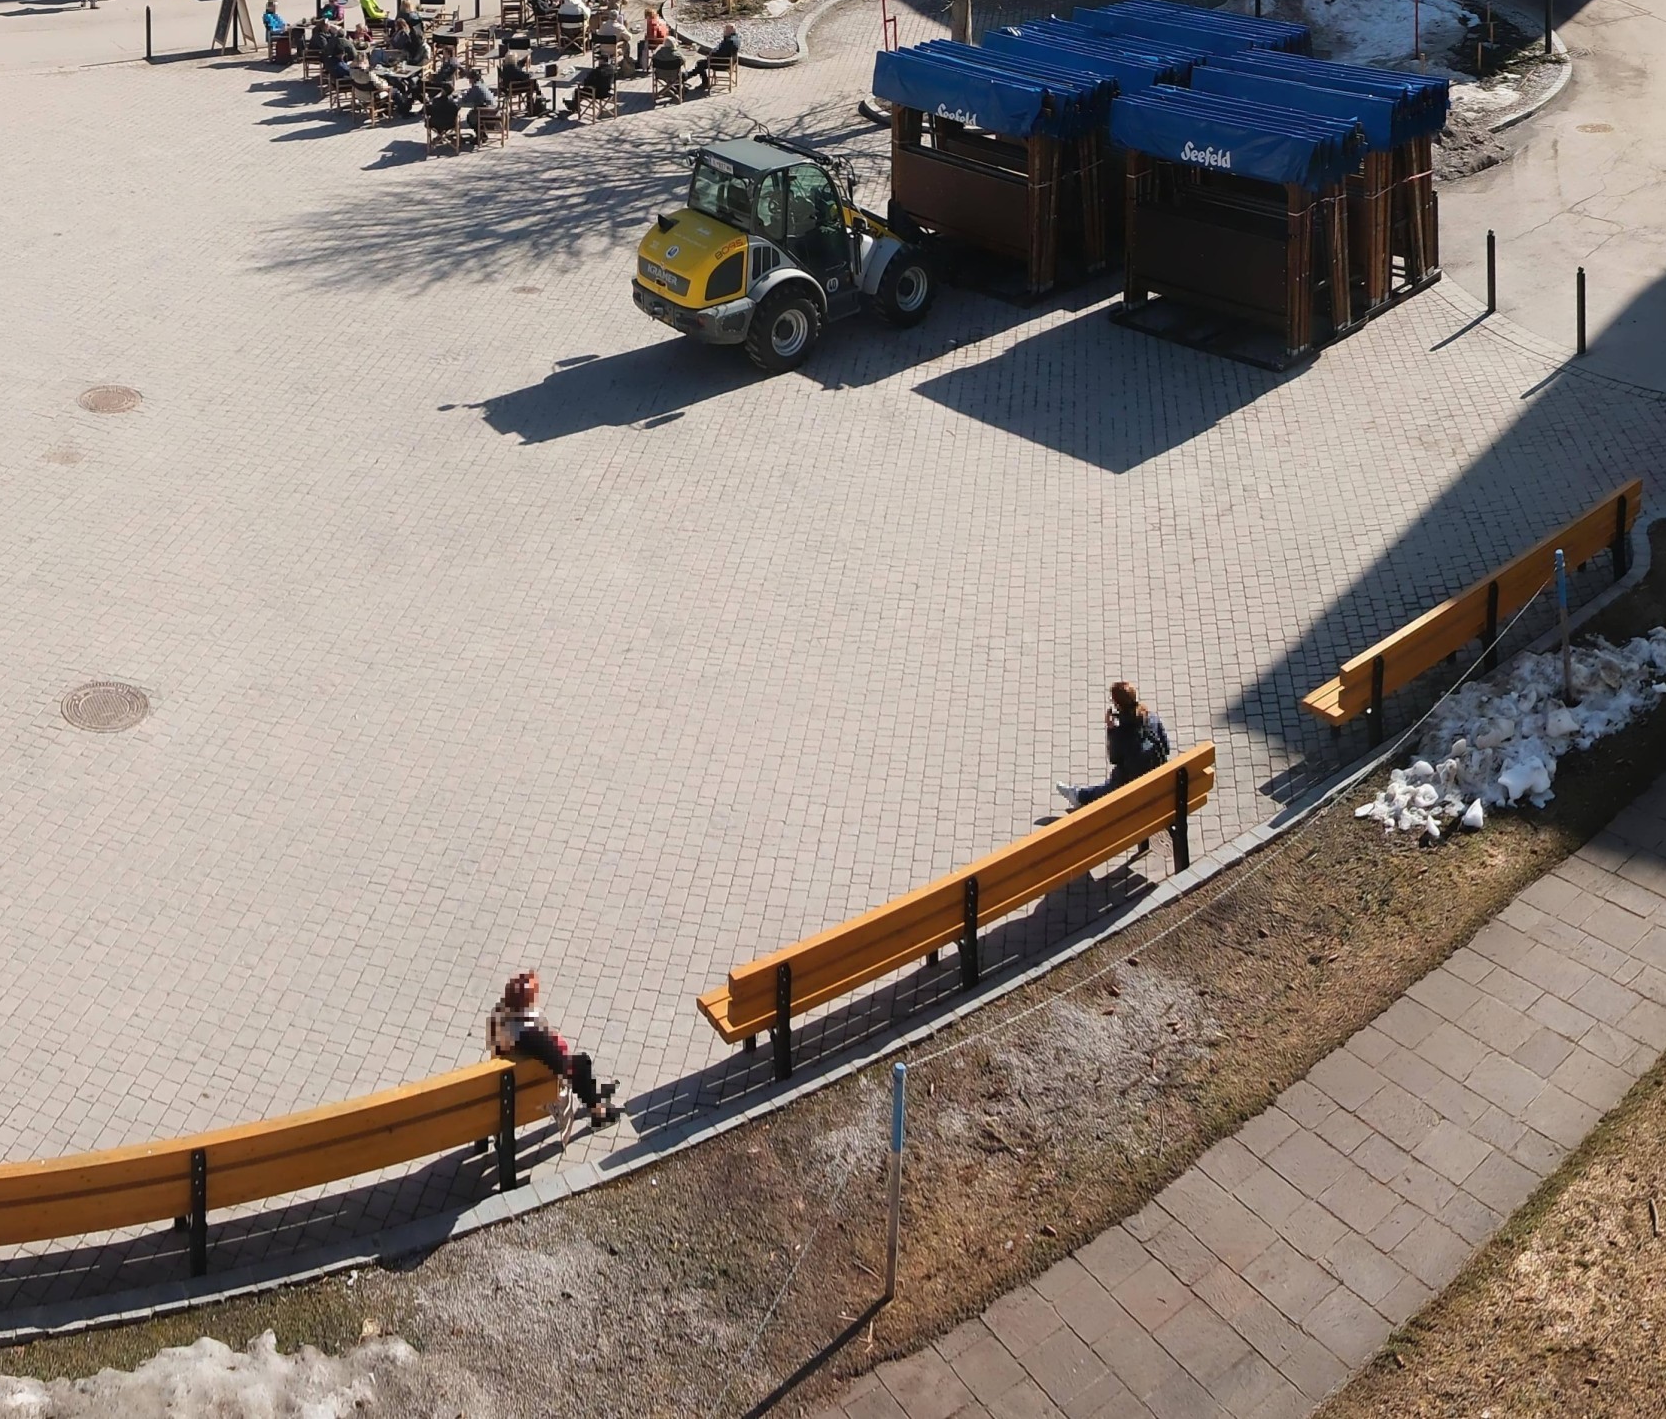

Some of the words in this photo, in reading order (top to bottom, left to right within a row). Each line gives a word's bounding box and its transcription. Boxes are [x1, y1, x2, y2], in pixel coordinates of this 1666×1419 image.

[936, 102, 977, 126] Seefeld
[1181, 140, 1231, 169] Seefeld
[647, 263, 678, 286] KRAMER
